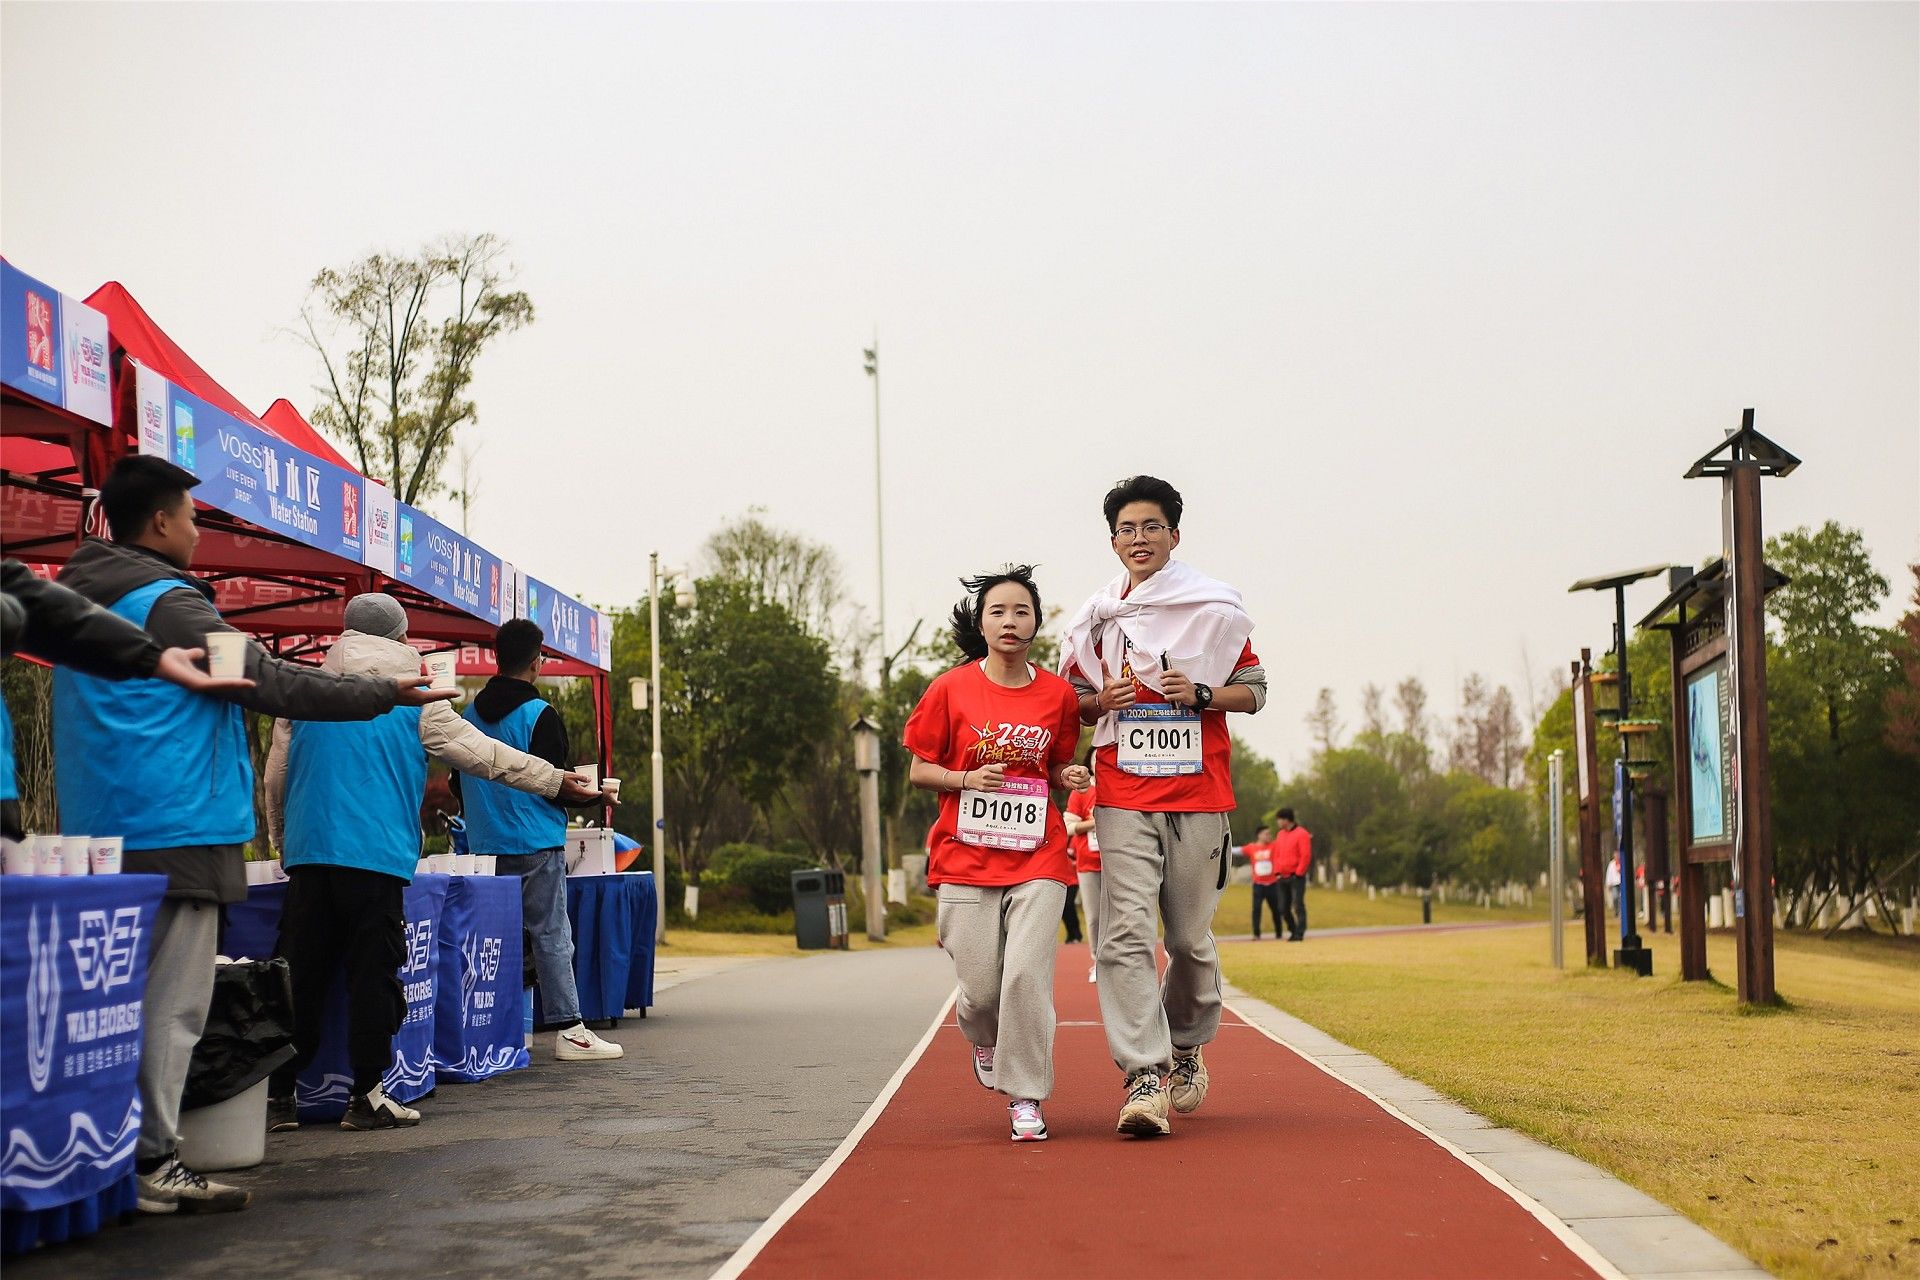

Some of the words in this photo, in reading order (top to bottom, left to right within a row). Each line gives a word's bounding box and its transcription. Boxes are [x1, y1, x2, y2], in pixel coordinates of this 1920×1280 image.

[218, 429, 262, 469] VOSS
[226, 467, 239, 481] LIVE
[240, 472, 257, 490] EVERY
[264, 446, 320, 512] 补水区
[269, 495, 292, 525] Water
[292, 505, 318, 536] Station
[428, 532, 453, 559] VOSS
[1127, 708, 1148, 719] 2020
[1129, 728, 1191, 750] C1001
[971, 797, 1037, 825] D1018
[66, 1010, 97, 1044] WAR
[97, 1000, 141, 1039] HORSE
